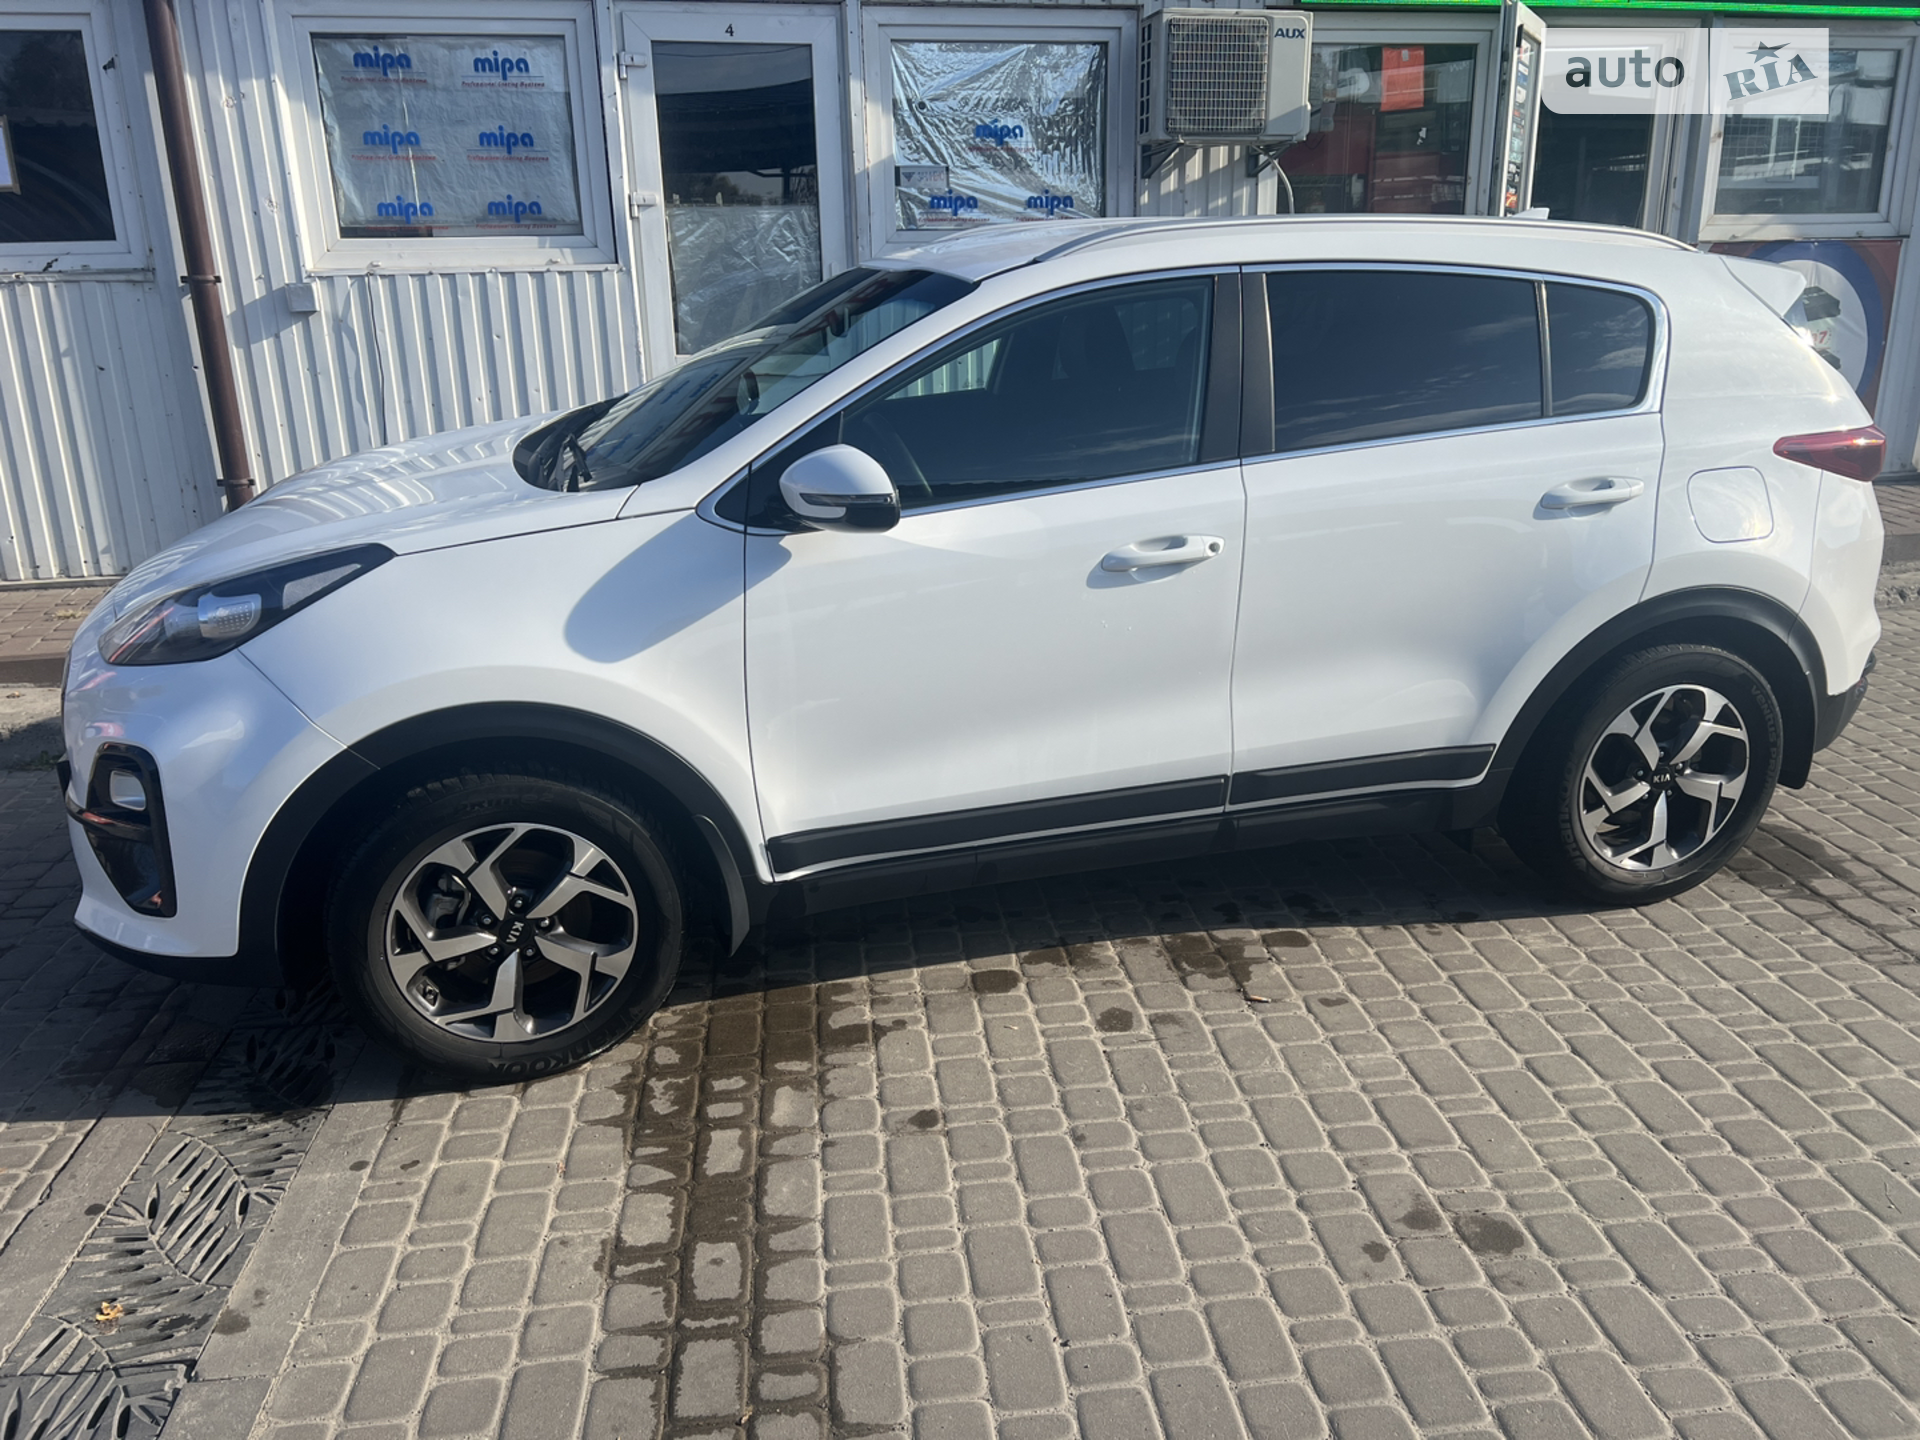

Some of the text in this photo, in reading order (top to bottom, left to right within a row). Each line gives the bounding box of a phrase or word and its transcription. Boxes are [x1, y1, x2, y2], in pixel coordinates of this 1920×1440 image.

[725, 23, 734, 37] 4
[1274, 28, 1306, 39] AUX
[353, 45, 411, 76] mipa
[473, 50, 530, 80] mipa
[363, 124, 421, 154] mipa
[479, 125, 534, 155] mipa
[975, 118, 1024, 146] mipa
[377, 195, 434, 224] mipa
[487, 194, 542, 222] mipa
[930, 189, 979, 216] mipa
[1027, 189, 1074, 216] mipa
[1652, 774, 1671, 784] KIA
[506, 921, 524, 942] KIA
